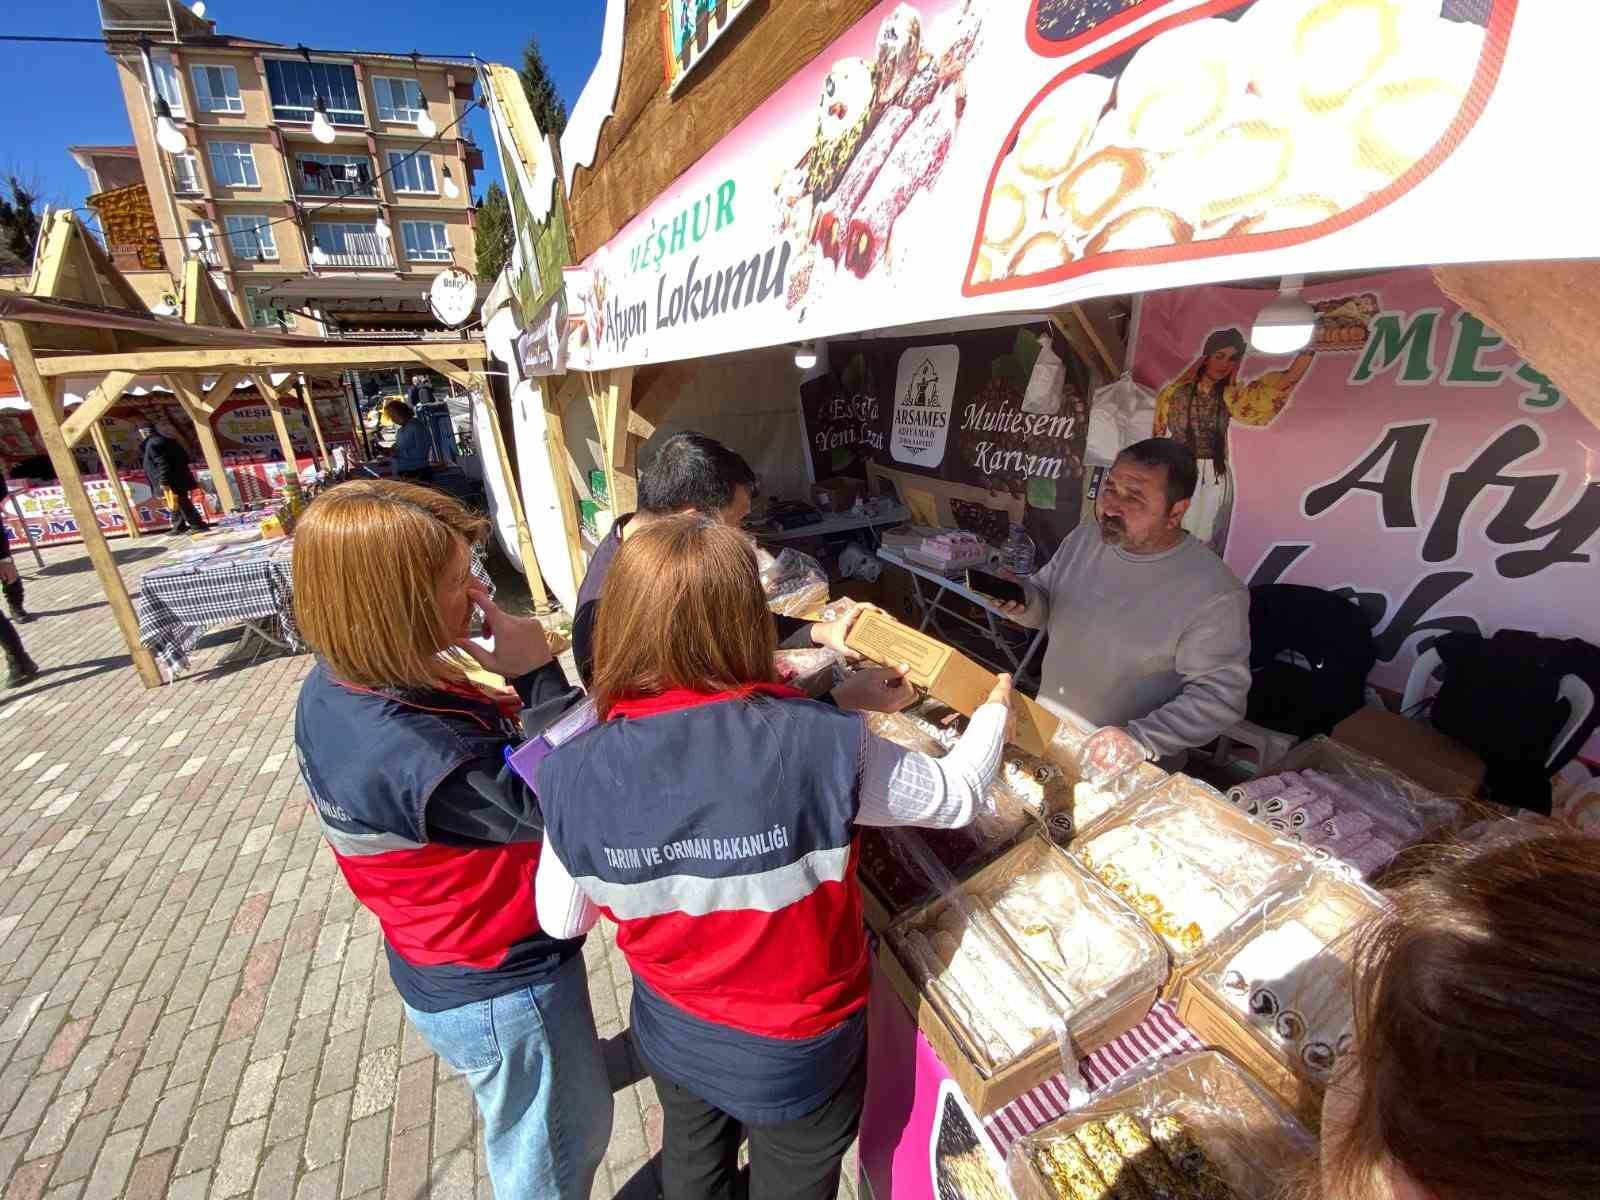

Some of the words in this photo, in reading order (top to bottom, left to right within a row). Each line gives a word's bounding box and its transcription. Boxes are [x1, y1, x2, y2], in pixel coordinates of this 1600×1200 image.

[606, 296, 647, 352] Afyon
[656, 241, 791, 330] Lokumu
[242, 432, 297, 443] KONK
[895, 409, 947, 428] ARSAMES
[961, 401, 1075, 441] Muhteşem
[1305, 423, 1600, 579] Afy
[604, 847, 640, 870] TARIM
[642, 847, 663, 867] VE
[663, 838, 712, 861] ORMAN
[713, 824, 789, 861] BAKANLIĞI
